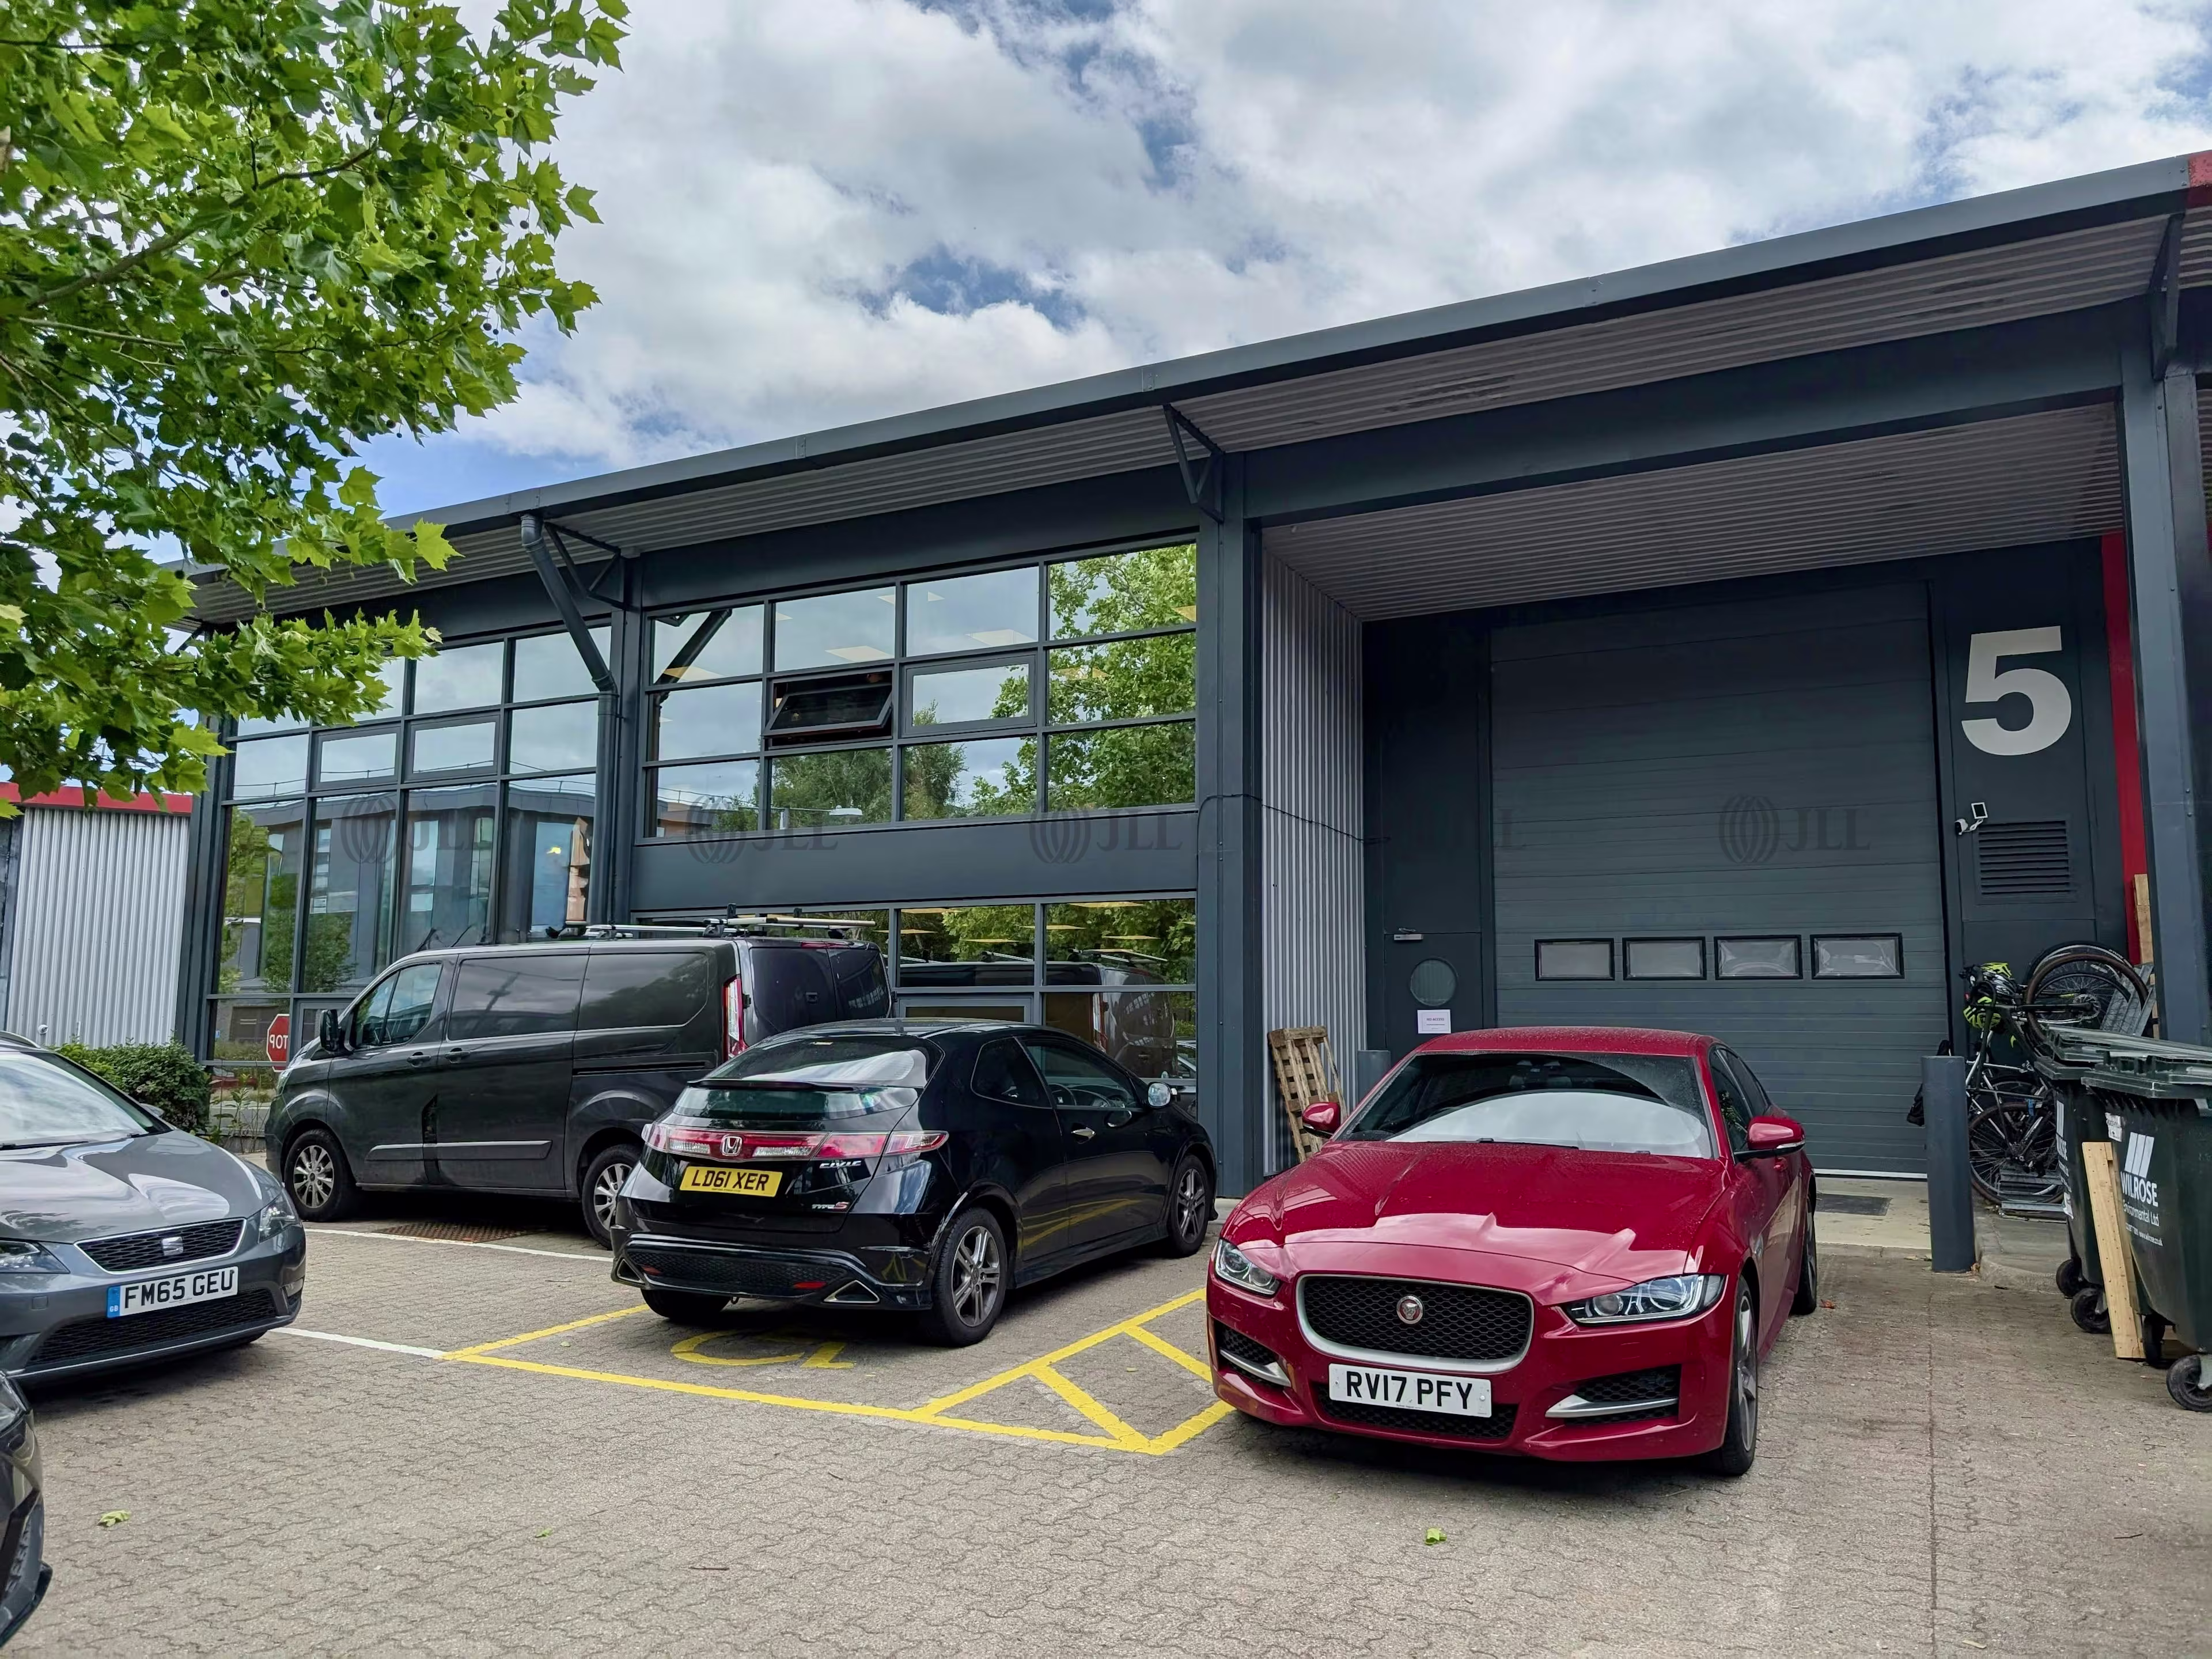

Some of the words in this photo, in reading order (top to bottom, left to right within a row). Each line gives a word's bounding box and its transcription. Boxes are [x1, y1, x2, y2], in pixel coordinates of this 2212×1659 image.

[1961, 626, 2072, 756] 5
[819, 1160, 862, 1169] CIVIC
[691, 1169, 732, 1188] LD61
[733, 1172, 770, 1191] XER
[2120, 1171, 2158, 1207] WILROSE
[835, 1201, 849, 1209] S
[2150, 1211, 2160, 1226] Ltd
[124, 1278, 186, 1309] FM65
[192, 1270, 234, 1296] GEU
[1346, 1371, 1407, 1403] RV17
[1417, 1378, 1472, 1410] PFY
